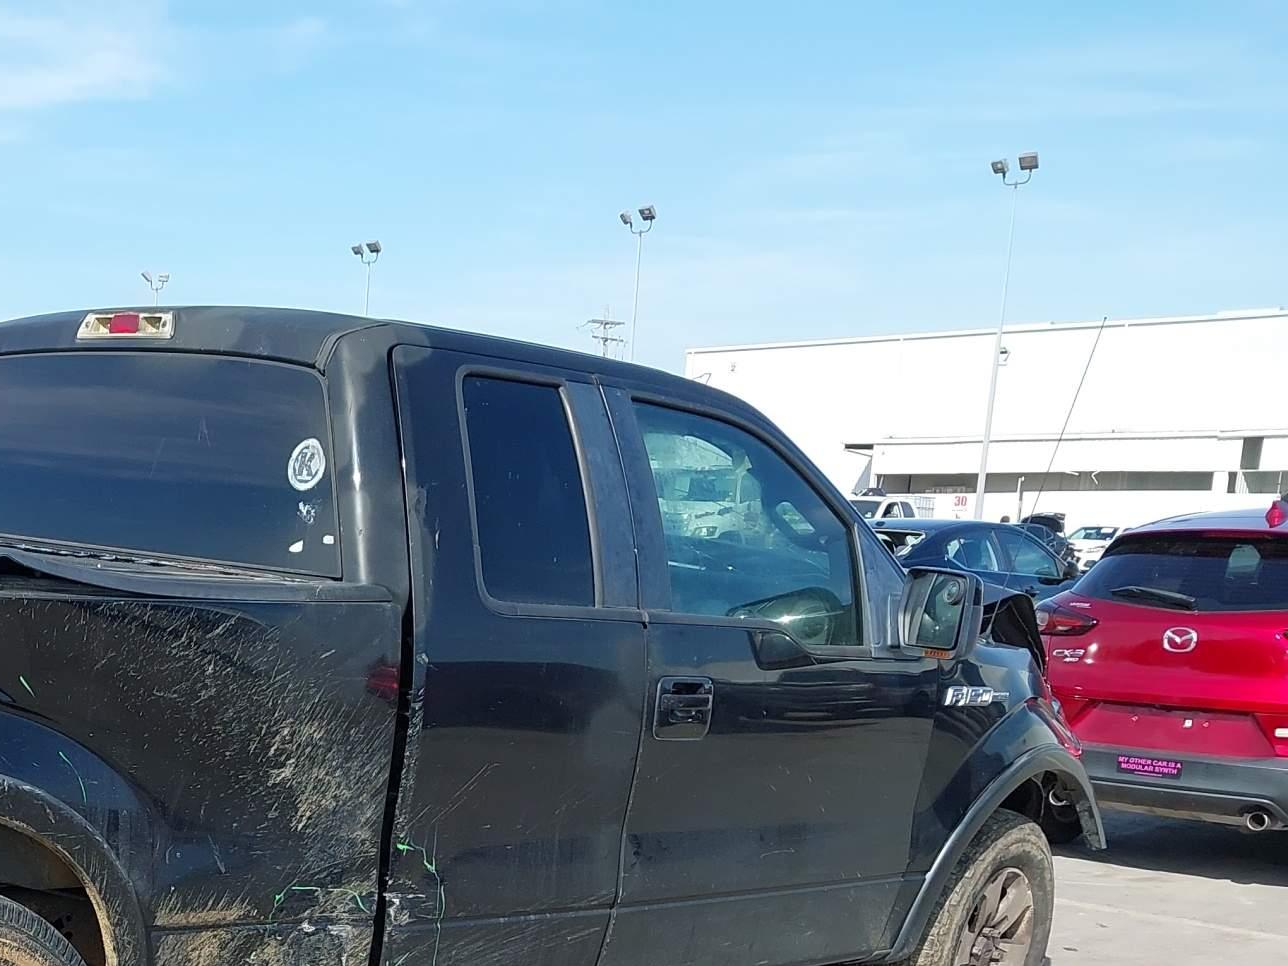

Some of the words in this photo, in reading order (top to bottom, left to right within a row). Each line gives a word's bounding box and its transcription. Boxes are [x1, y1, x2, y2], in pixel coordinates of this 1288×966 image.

[954, 495, 968, 507] 30
[1129, 757, 1152, 765] OTHER
[1121, 763, 1154, 771] MODULAR
[1154, 766, 1178, 774] SYNTH
